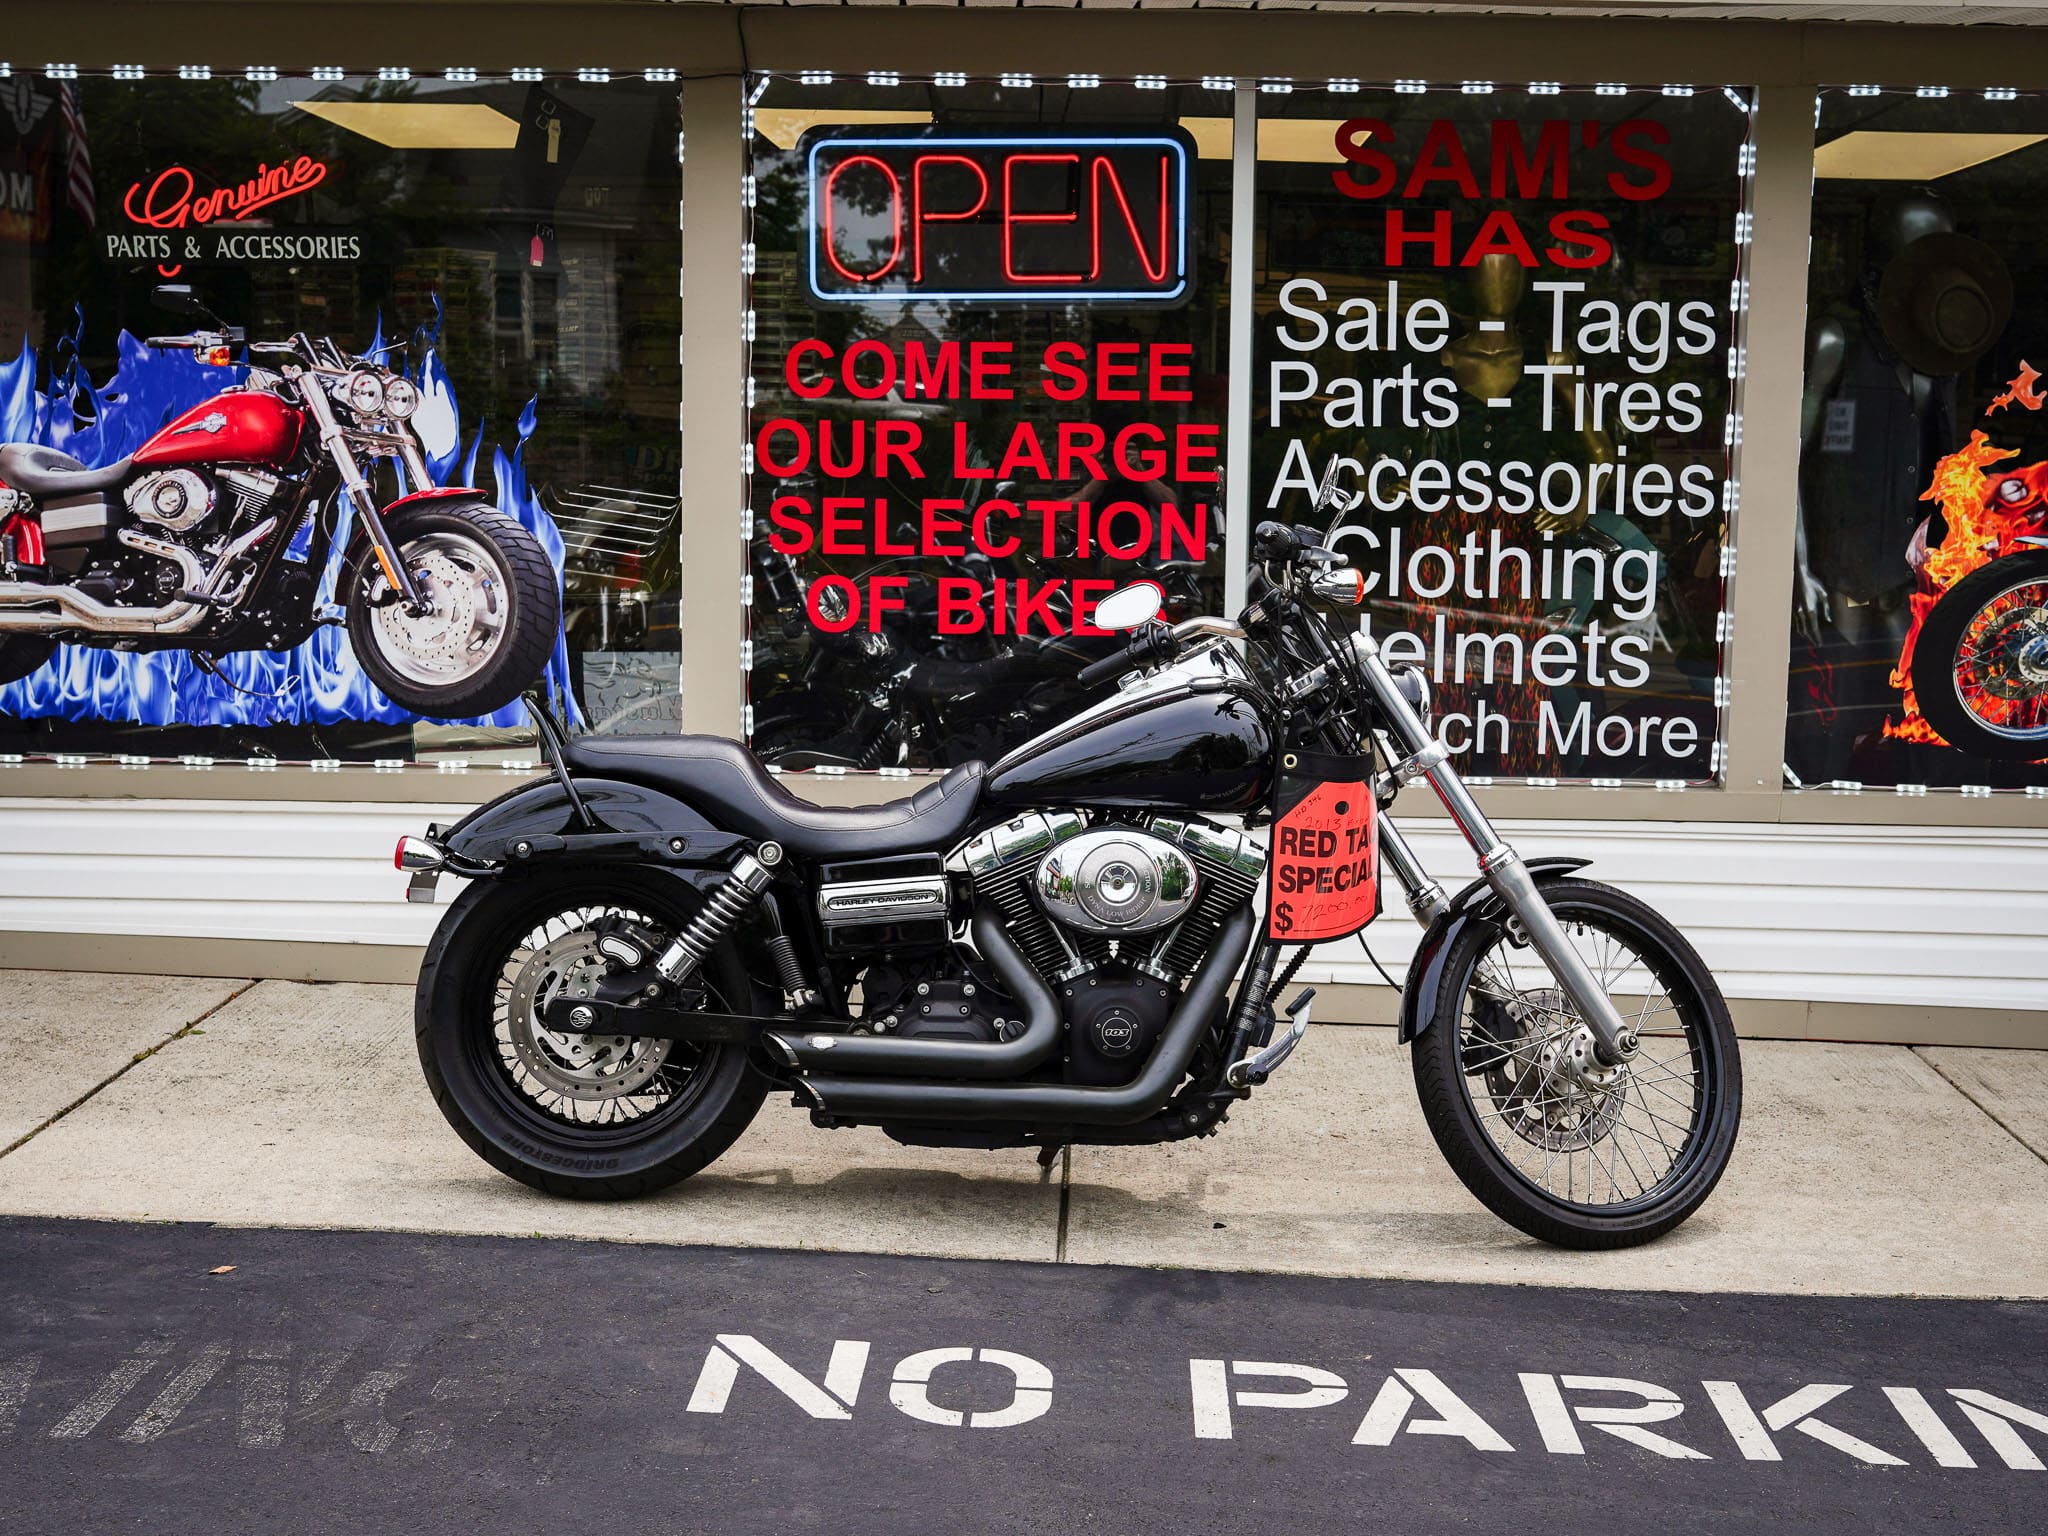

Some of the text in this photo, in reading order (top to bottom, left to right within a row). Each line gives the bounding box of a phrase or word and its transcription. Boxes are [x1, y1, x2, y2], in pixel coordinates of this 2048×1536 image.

[1331, 118, 1672, 201] SAM'S
[124, 156, 326, 228] Genuine
[823, 153, 1169, 284] OPEN
[106, 235, 361, 260] PARTS & ACCESSORIES
[1385, 210, 1612, 268] HAS
[1276, 278, 1450, 353] Sale
[1532, 281, 1717, 374] Tags
[785, 338, 1193, 402] COME SEE
[1270, 360, 1460, 429] Parts
[1524, 364, 1703, 434] Tires
[756, 417, 926, 479] OUR
[953, 421, 1221, 483] LARGE
[1267, 438, 1715, 518] Accessories
[767, 496, 1207, 561] SELECTION
[806, 574, 909, 634] OF
[1320, 612, 1651, 688] elmets
[1537, 700, 1698, 759] More
[1280, 826, 1338, 858] RED
[835, 893, 930, 907] HARLEY-DAVIDSON
[1278, 855, 1375, 894] SPECIAL
[1274, 900, 1294, 936] $
[1104, 1028, 1130, 1037] 103
[502, 1132, 620, 1170] BRIDGESTONE
[686, 1333, 1055, 1428] NO
